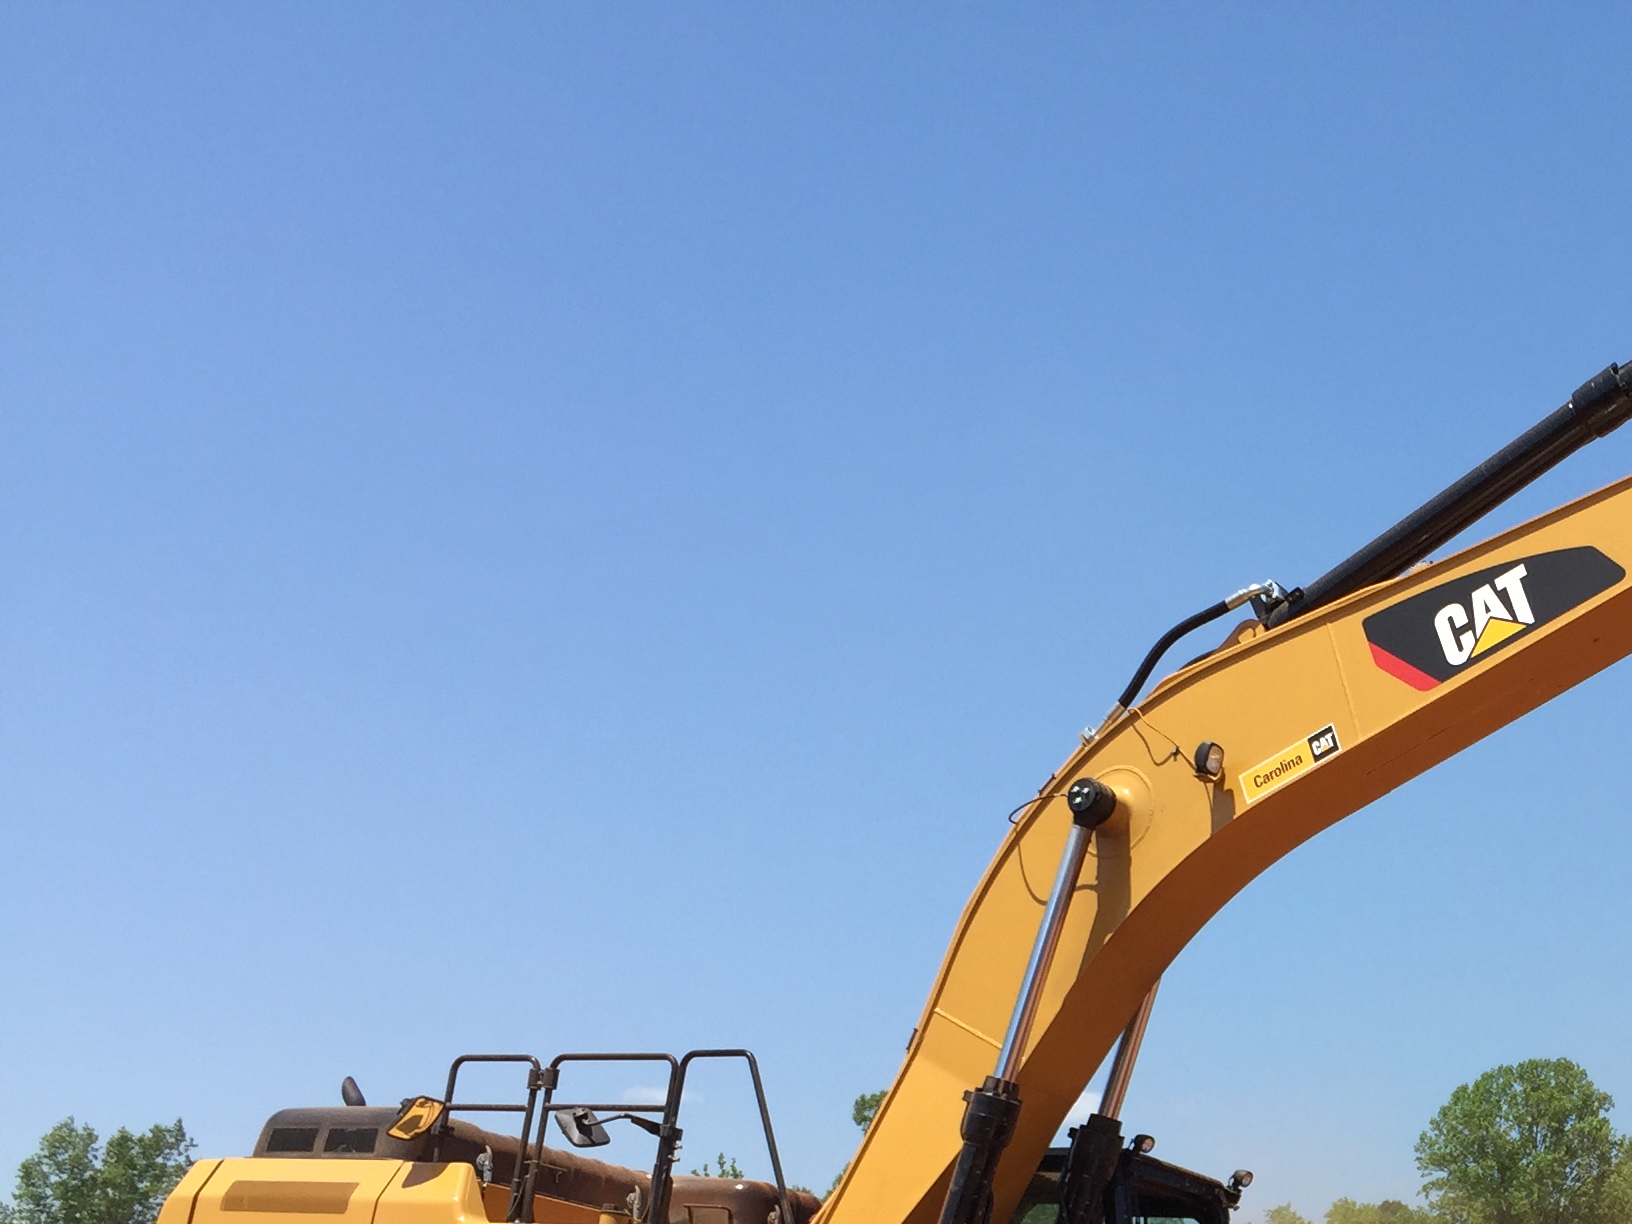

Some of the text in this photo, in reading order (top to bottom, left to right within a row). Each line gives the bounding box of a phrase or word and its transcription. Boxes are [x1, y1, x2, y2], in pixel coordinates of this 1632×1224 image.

[1434, 563, 1536, 666] CAT
[1253, 732, 1335, 788] Carolina CAT
